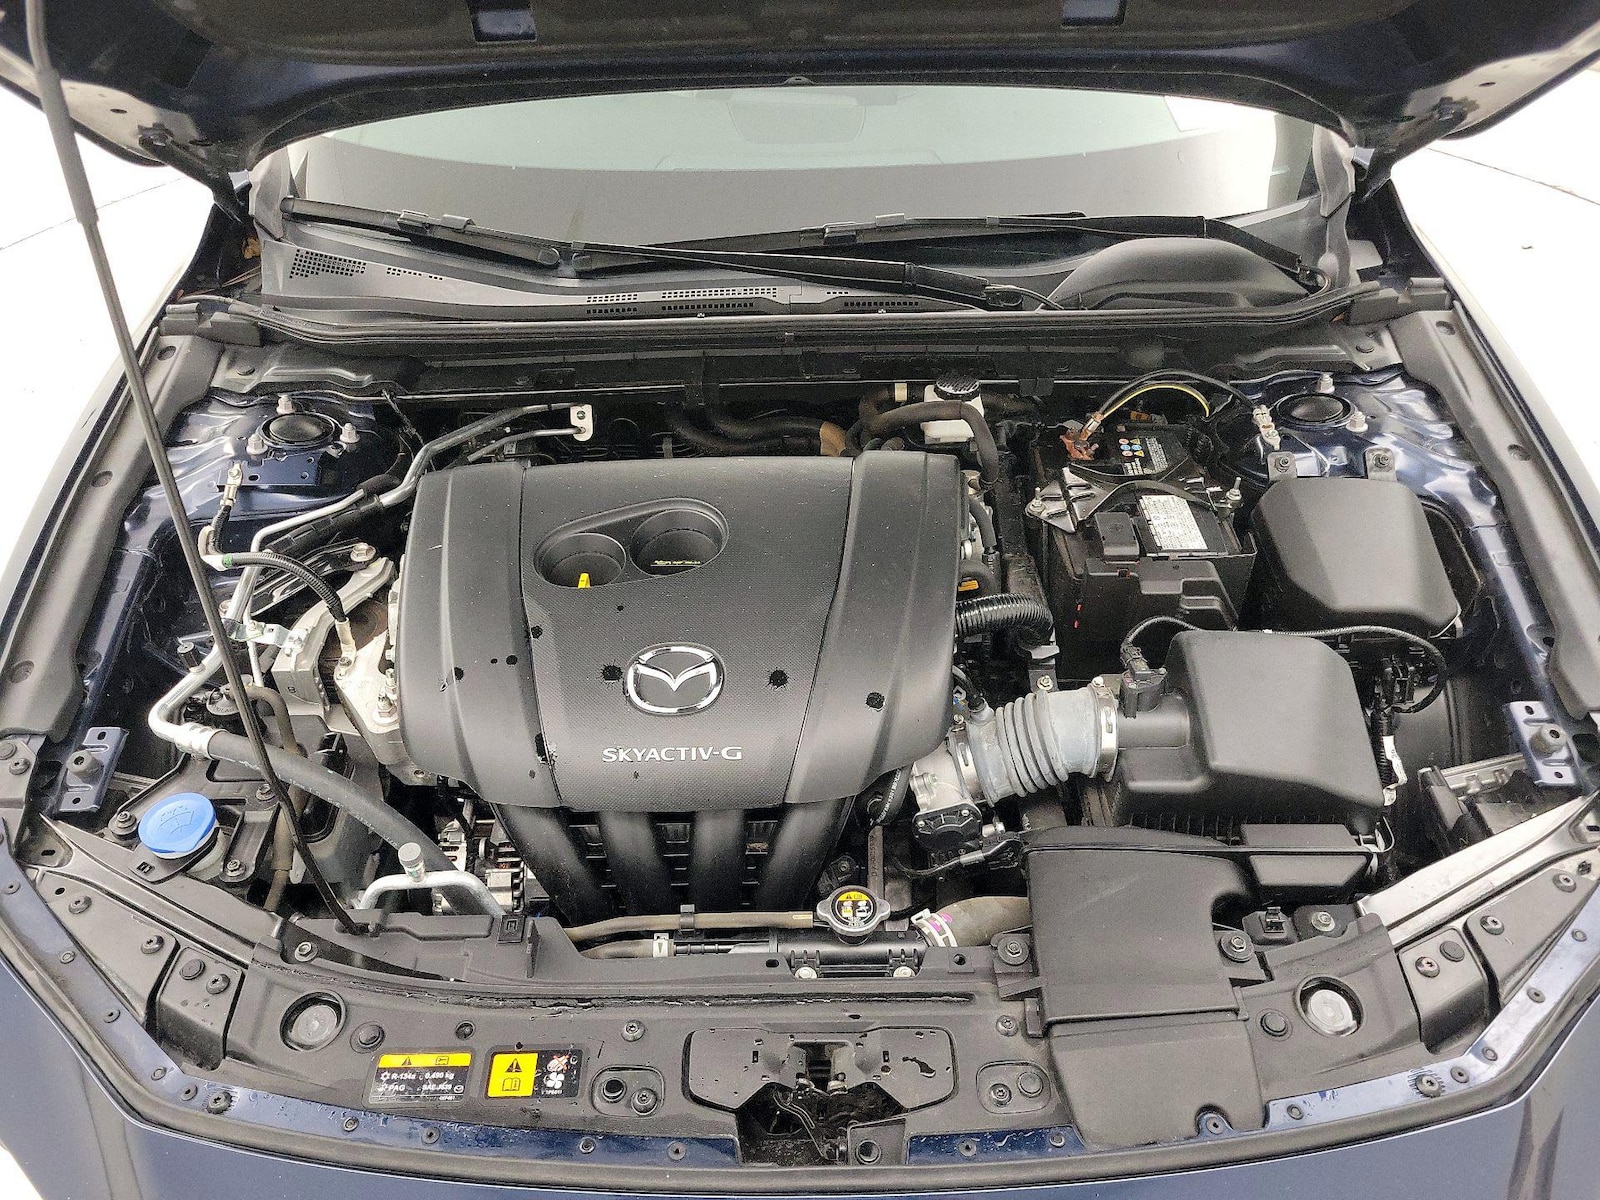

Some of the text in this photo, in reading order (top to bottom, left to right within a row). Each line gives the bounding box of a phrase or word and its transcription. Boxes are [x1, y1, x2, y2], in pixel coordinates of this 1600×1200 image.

[602, 746, 742, 762] SKYACTIV-G
[445, 1071, 455, 1081] kg
[388, 1084, 406, 1092] PAG
